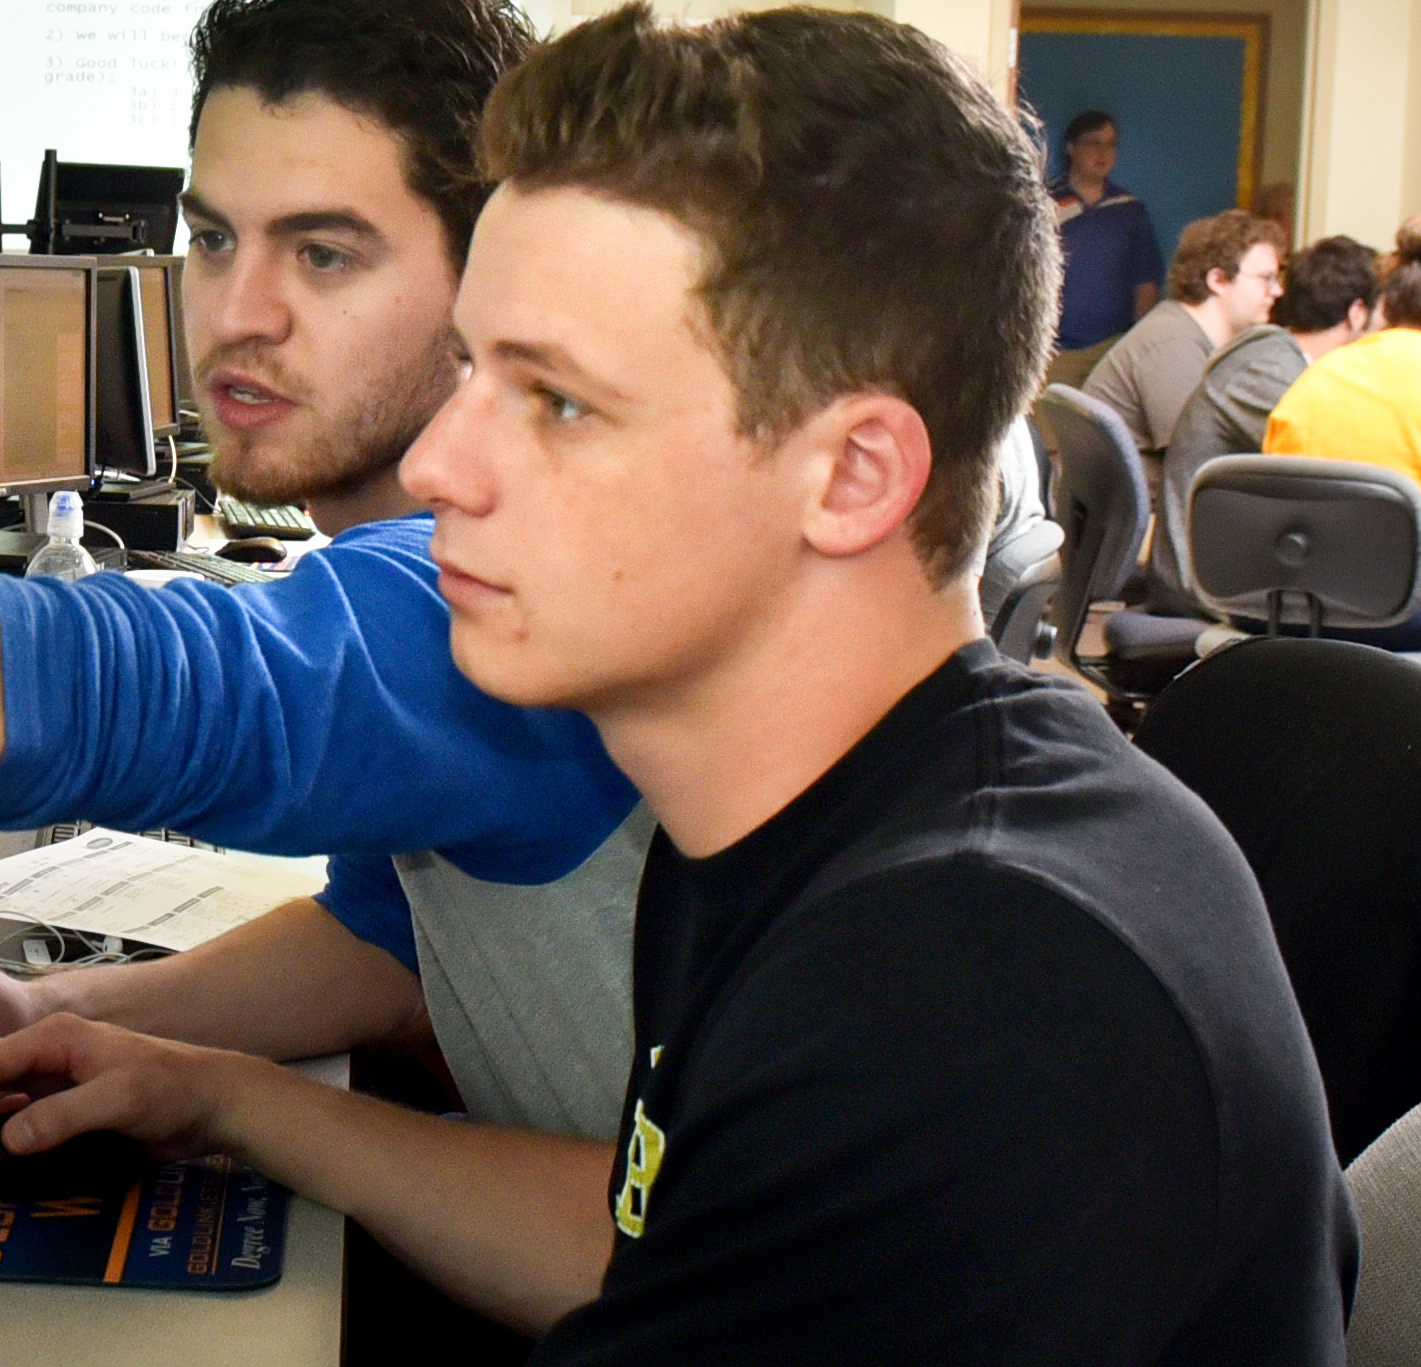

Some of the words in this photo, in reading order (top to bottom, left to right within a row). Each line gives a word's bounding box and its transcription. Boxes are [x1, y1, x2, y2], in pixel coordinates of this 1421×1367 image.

[46, 2, 118, 16] company
[130, 3, 171, 14] code
[107, 29, 149, 41] will
[75, 57, 117, 69] Good
[147, 1236, 173, 1258] VIA
